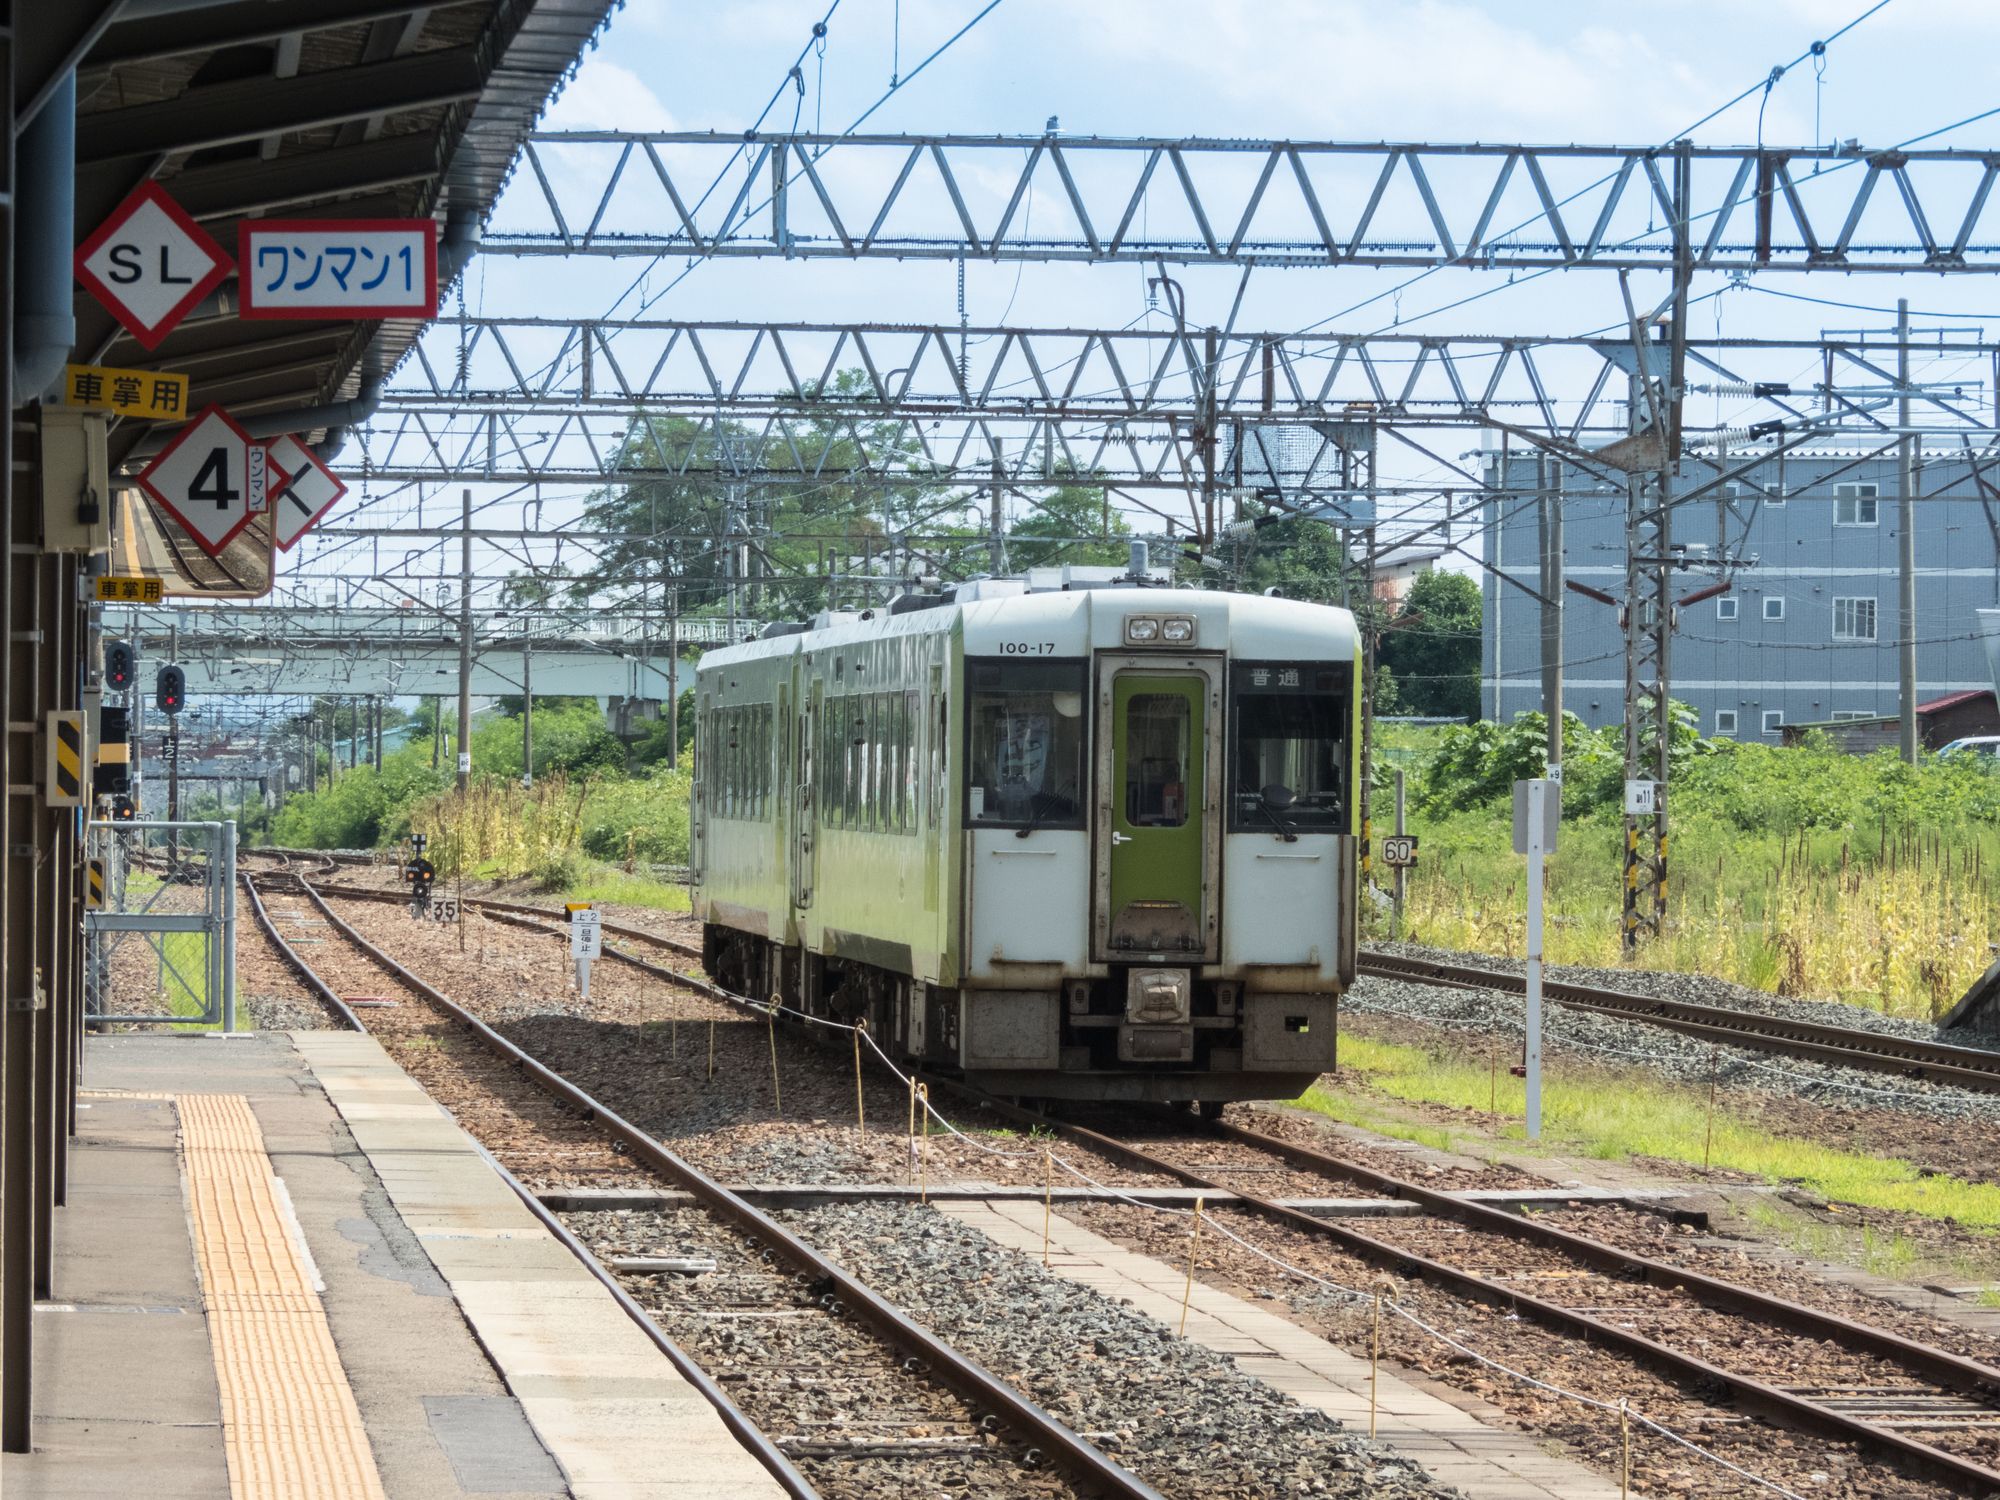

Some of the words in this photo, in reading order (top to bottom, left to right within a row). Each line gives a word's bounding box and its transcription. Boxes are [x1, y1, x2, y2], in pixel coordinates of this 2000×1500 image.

[108, 244, 192, 284] SL
[259, 246, 411, 292] ワンマン1
[73, 373, 181, 412] 車掌用
[188, 447, 239, 510] 4
[251, 451, 263, 506] ワンマン
[101, 581, 159, 599] 車掌用
[999, 642, 1055, 654] 100-17
[1249, 668, 1300, 687] 普通
[1385, 841, 1409, 861] 60
[433, 901, 457, 922] 35
